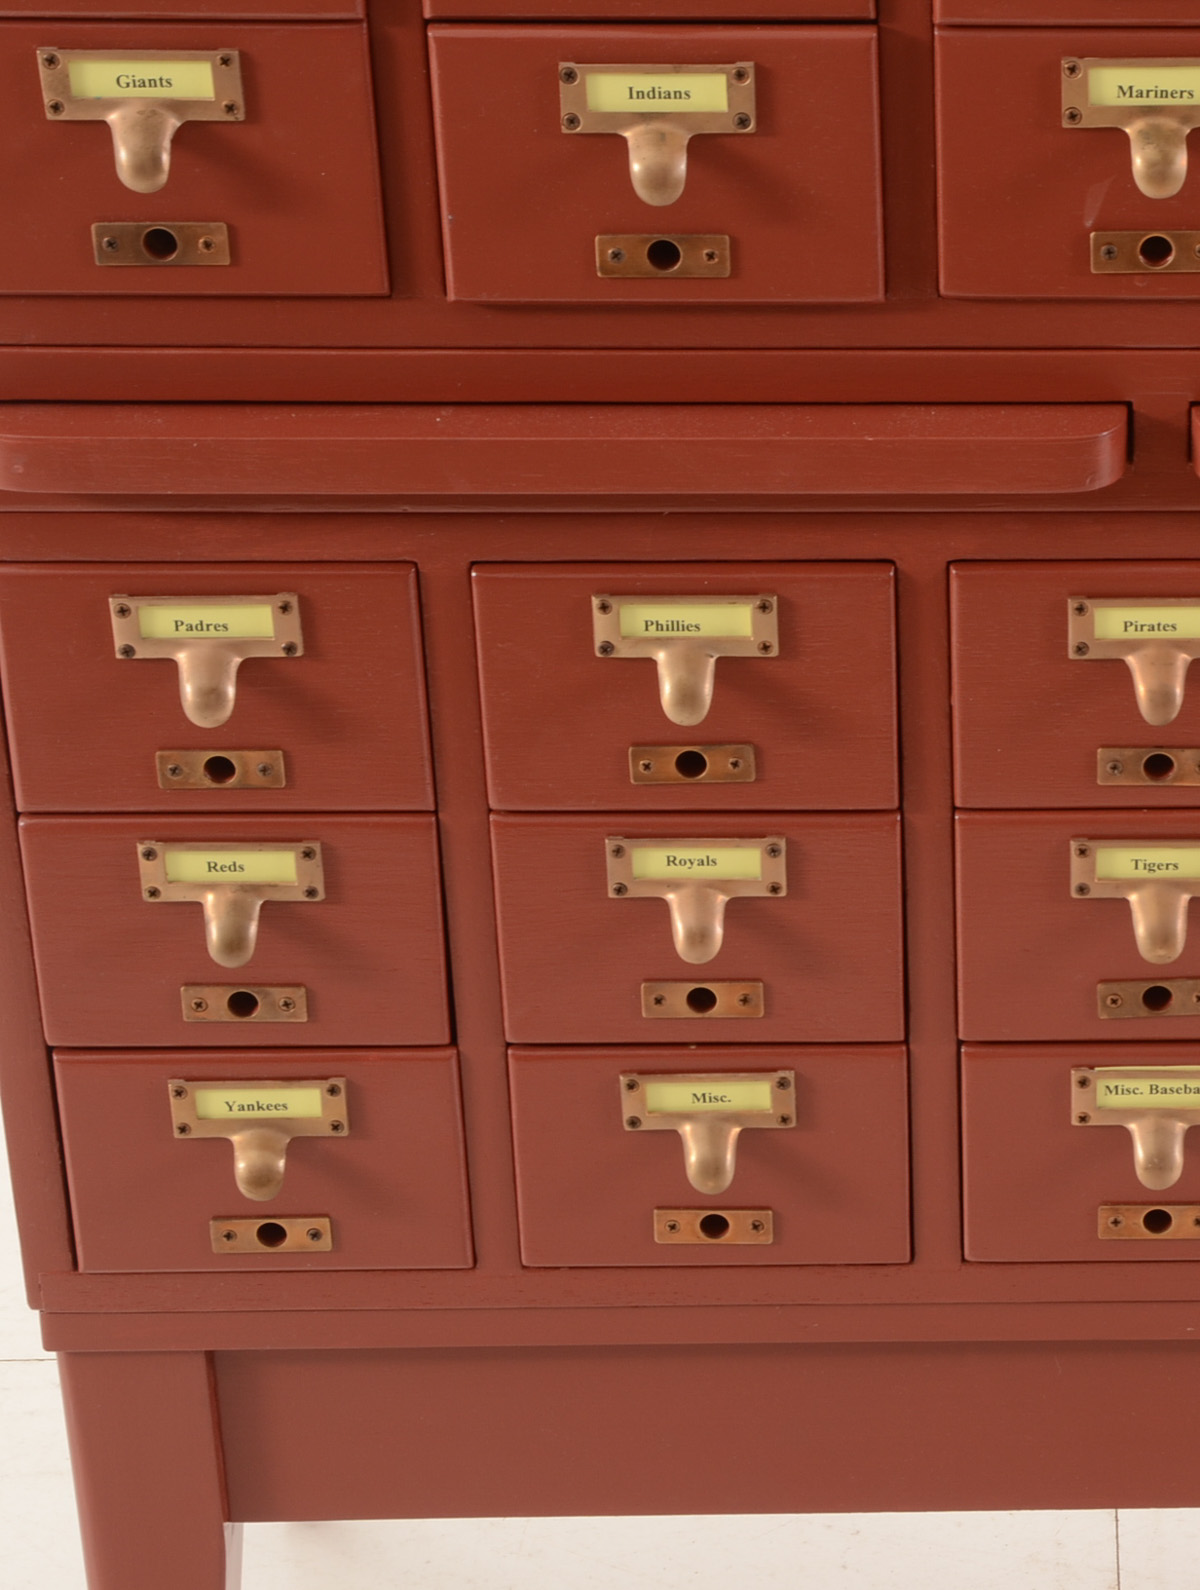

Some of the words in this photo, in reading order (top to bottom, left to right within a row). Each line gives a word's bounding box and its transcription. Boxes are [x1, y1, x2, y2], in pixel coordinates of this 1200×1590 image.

[115, 74, 173, 89] Giants
[628, 86, 691, 101] Indians
[1116, 85, 1195, 100] Mariners
[173, 620, 229, 633] Padres
[643, 619, 701, 633] Phillies
[1122, 620, 1178, 633] Pirates
[206, 861, 246, 874] Reds
[666, 855, 718, 870] Royals
[1130, 859, 1180, 874] Tigers
[1104, 1084, 1144, 1096] Misc.
[691, 1092, 732, 1104] Misc.
[224, 1100, 289, 1112] Yankees
